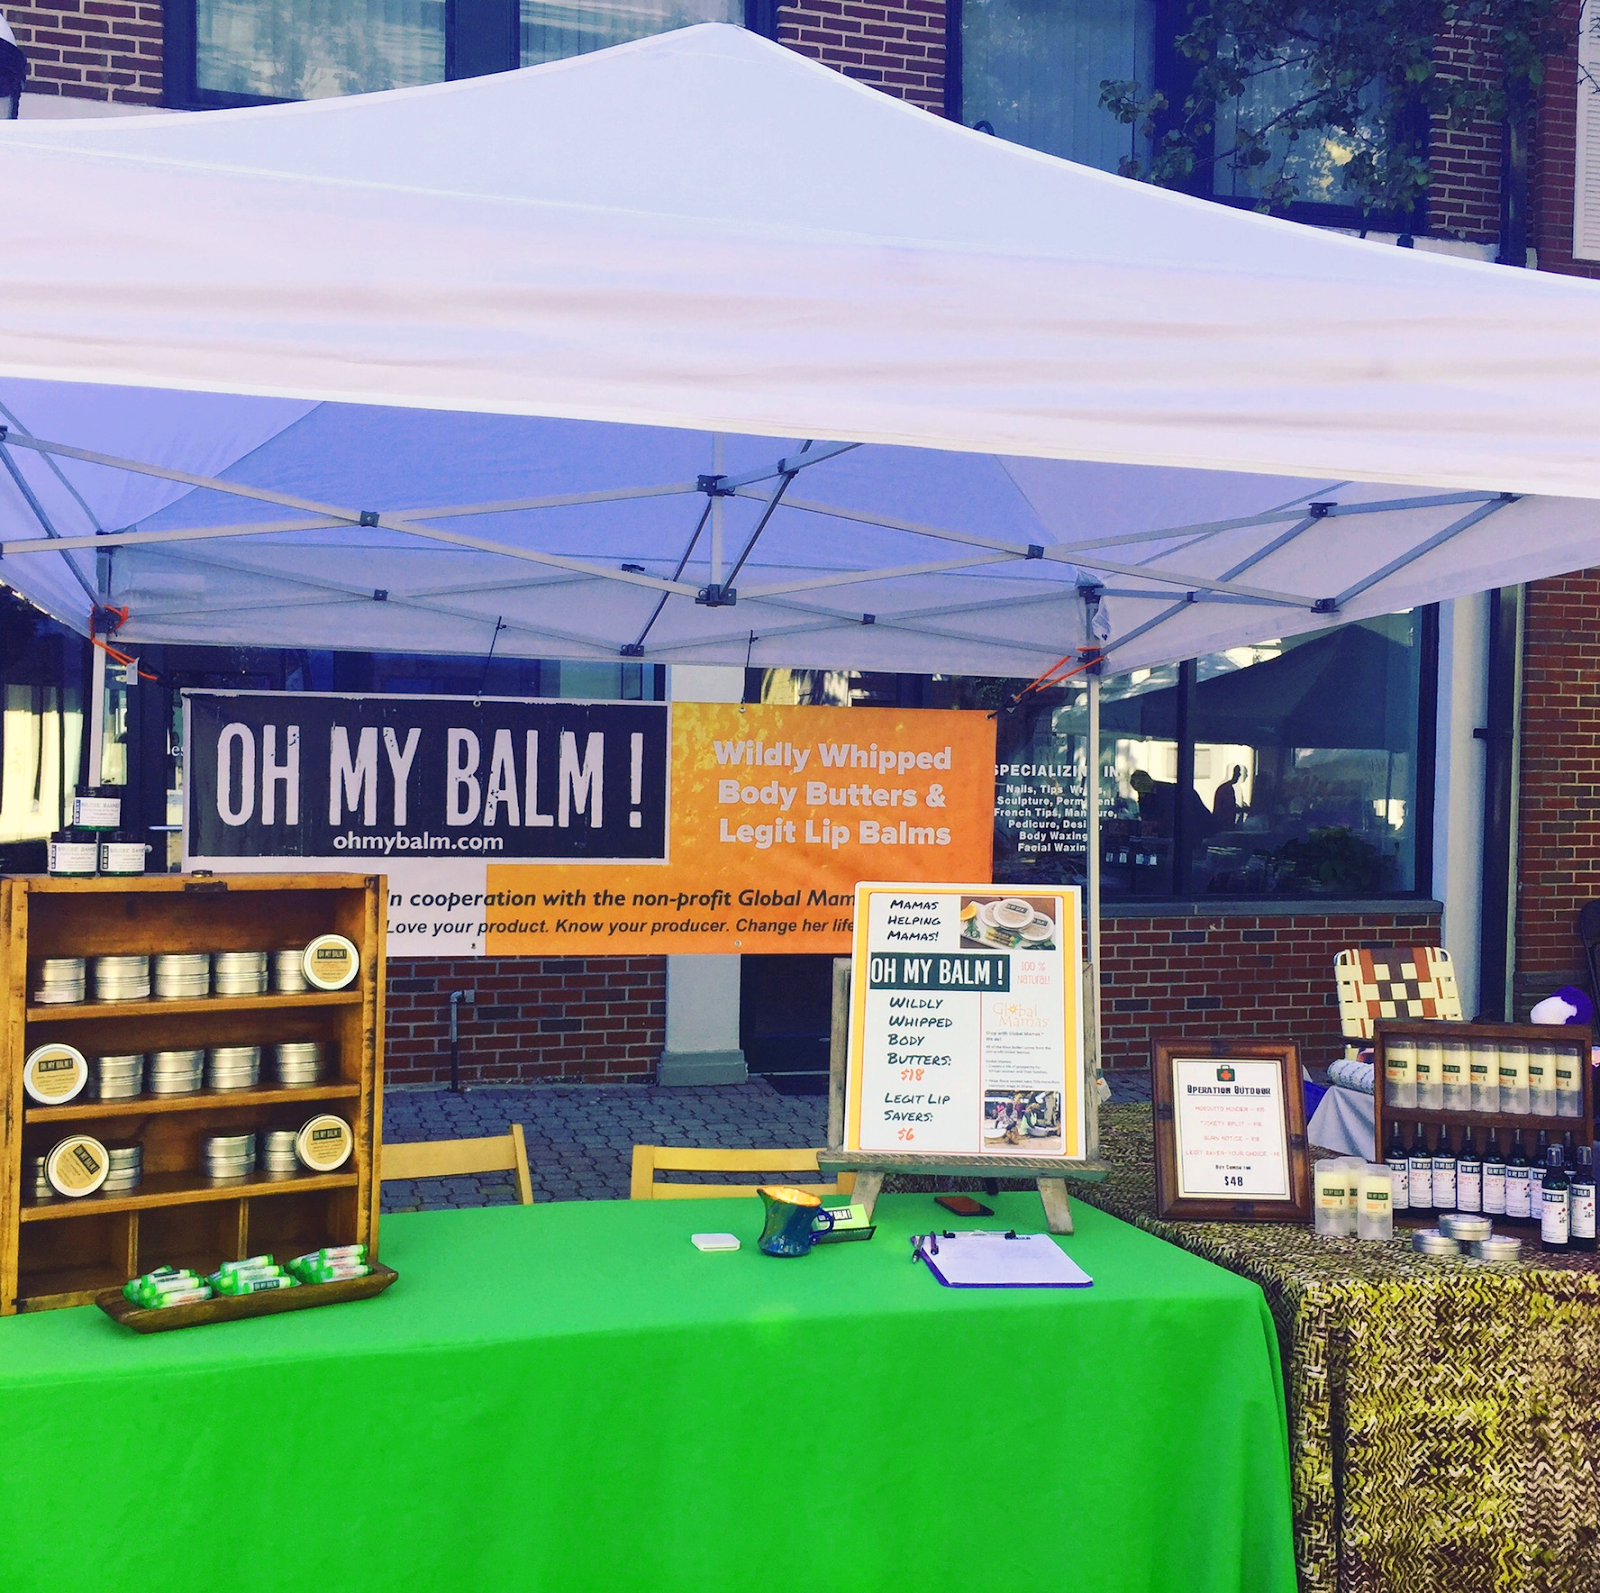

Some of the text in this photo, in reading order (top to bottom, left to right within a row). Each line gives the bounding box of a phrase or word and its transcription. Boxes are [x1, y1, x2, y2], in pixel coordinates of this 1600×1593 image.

[713, 740, 952, 775] Wildly Whipped
[216, 722, 300, 826] OH
[329, 725, 422, 826] MY
[446, 726, 604, 828] BALM
[994, 764, 1087, 777] SPECIALIZIN
[718, 779, 946, 811] Body Butters &
[1006, 785, 1037, 795] Nails,
[996, 796, 1115, 807] Sculpture, Perment
[994, 808, 1118, 818] French Tips, Manure,
[1008, 820, 1060, 830] Pedicure,
[719, 817, 952, 849] Legit Lip Balms
[1019, 831, 1046, 842] Body
[333, 831, 504, 854] ohmybalm.com
[1018, 843, 1087, 852] Facial Waxin
[410, 889, 537, 911] cooperation
[543, 889, 586, 906] with
[593, 889, 625, 906] the
[632, 889, 731, 911] non-profit
[738, 889, 801, 907] Global
[806, 889, 855, 906] Mam
[890, 899, 939, 910] MAMAS
[887, 915, 941, 926] HELPING
[386, 919, 427, 934] Love
[432, 922, 473, 937] your
[477, 919, 549, 936] product.
[555, 919, 603, 933] Know
[608, 920, 647, 936] your
[651, 918, 730, 935] producer.
[735, 918, 797, 935] Change
[801, 918, 828, 932] her
[886, 930, 939, 942] MAMAS!
[870, 957, 896, 984] OH
[903, 958, 933, 984] MY
[939, 958, 991, 985] BALM
[889, 997, 943, 1009] WILDLY
[888, 1015, 953, 1028] WHIPPED
[887, 1033, 925, 1046] BODY
[887, 1052, 952, 1066] BUTTERS:
[901, 1068, 925, 1081] $18
[1187, 1085, 1271, 1095] OPERATION OUTDOOR
[884, 1092, 951, 1105] LEGIT LIP
[883, 1109, 933, 1122] SAVERS:
[897, 1127, 915, 1141] $6
[1224, 1175, 1244, 1187] $48
